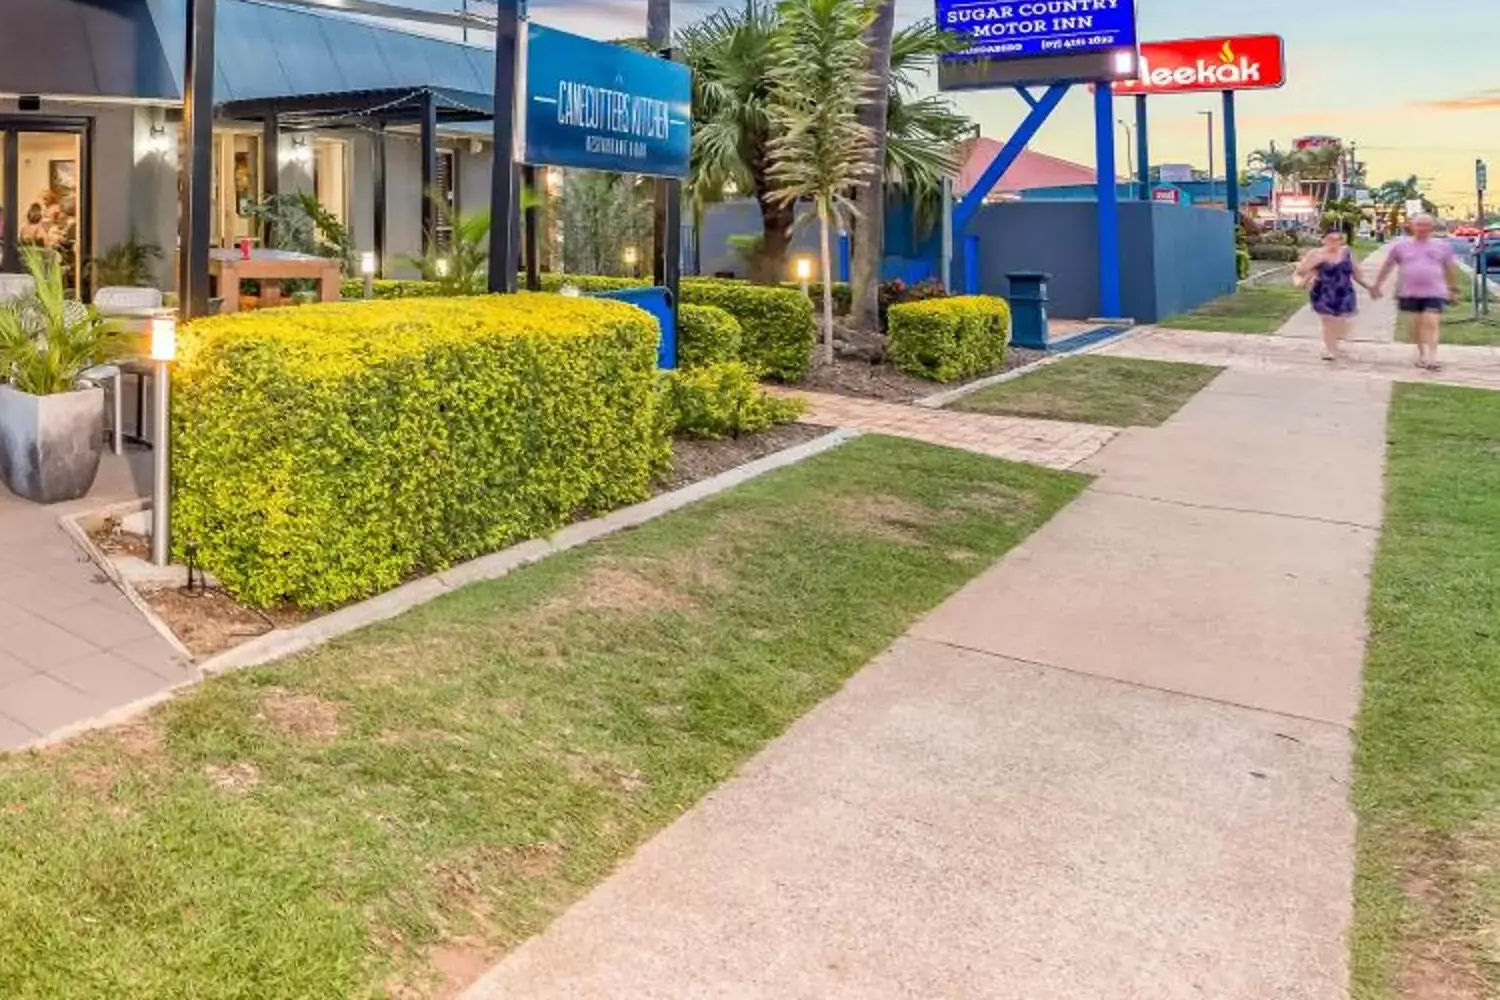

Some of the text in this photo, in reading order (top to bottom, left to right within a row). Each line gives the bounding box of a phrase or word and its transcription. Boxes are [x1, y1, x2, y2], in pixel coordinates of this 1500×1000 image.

[947, 6, 1013, 23] SUGAR
[973, 16, 1093, 37] MOTOR INN
[557, 80, 669, 140] CANECUTTERS KITCHEN
